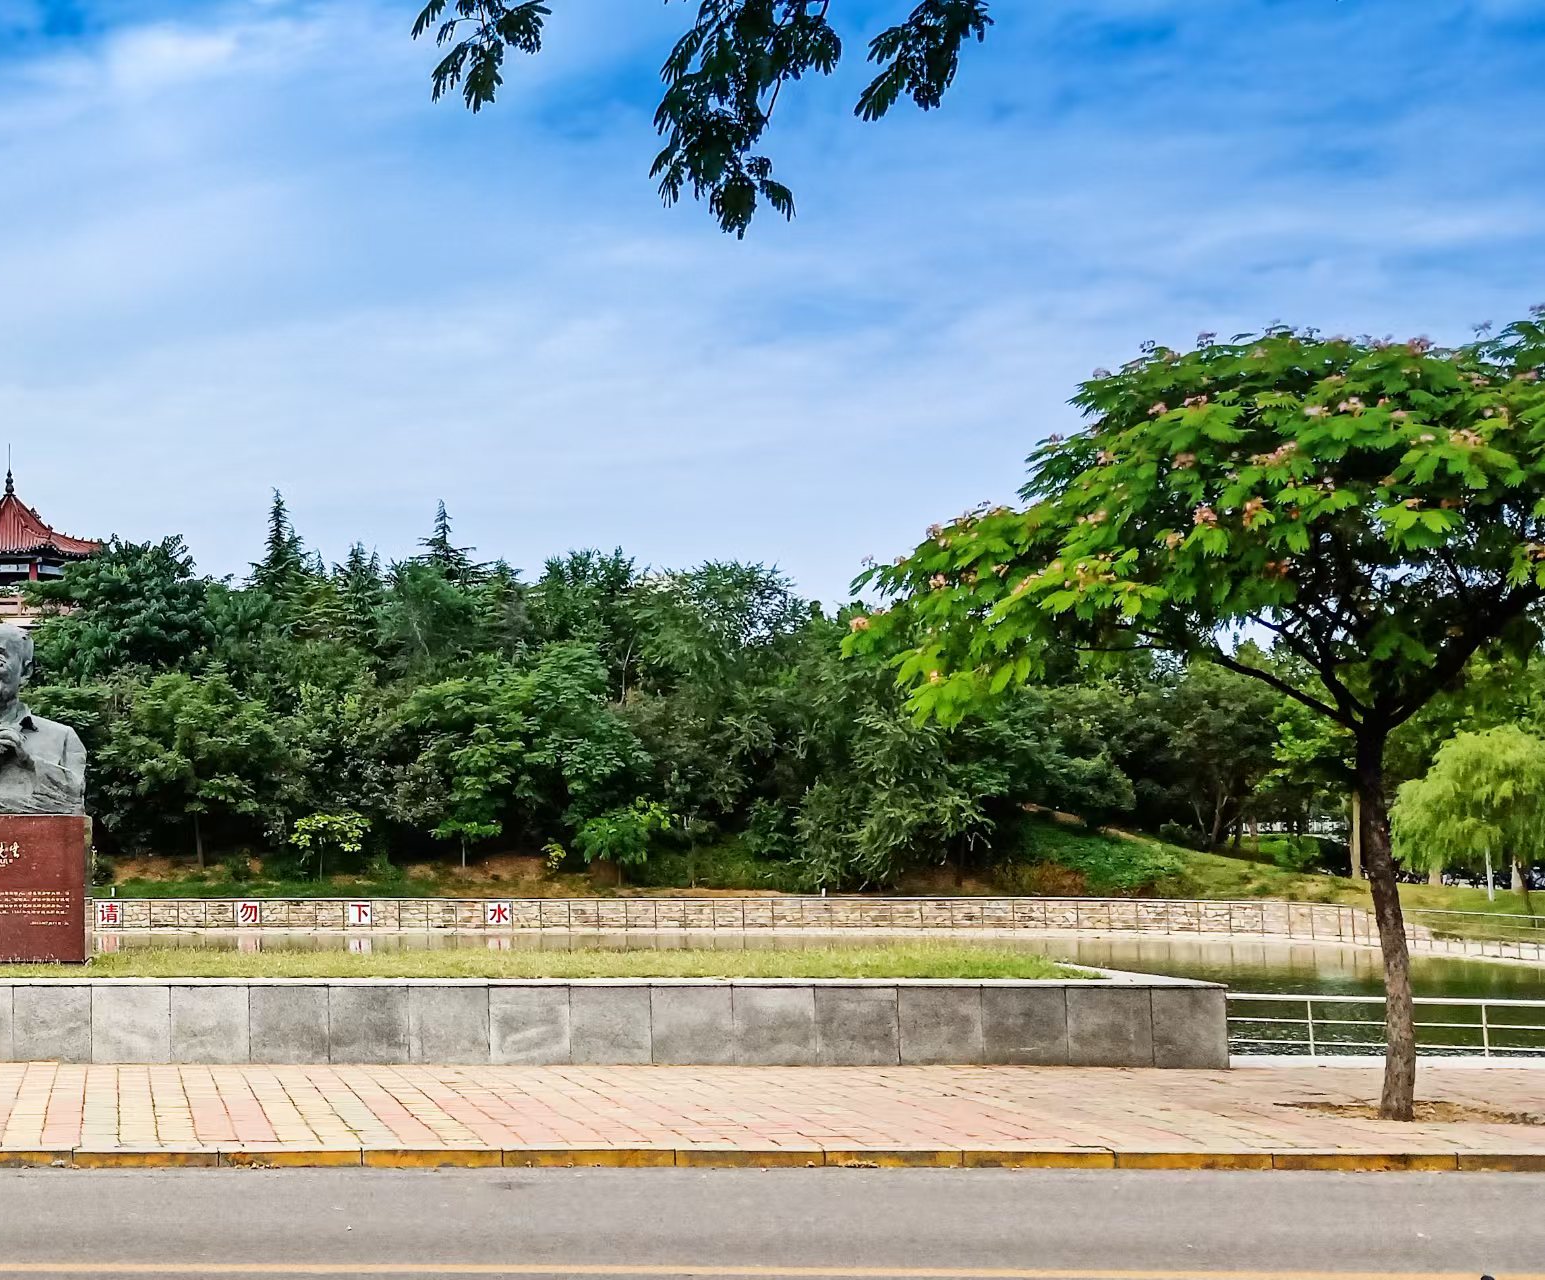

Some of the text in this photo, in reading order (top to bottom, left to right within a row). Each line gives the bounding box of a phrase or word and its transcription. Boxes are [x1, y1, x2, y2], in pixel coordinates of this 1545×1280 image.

[100, 903, 118, 923] 请
[240, 903, 258, 922] 勿
[351, 904, 369, 922] 下
[490, 904, 508, 923] 水
